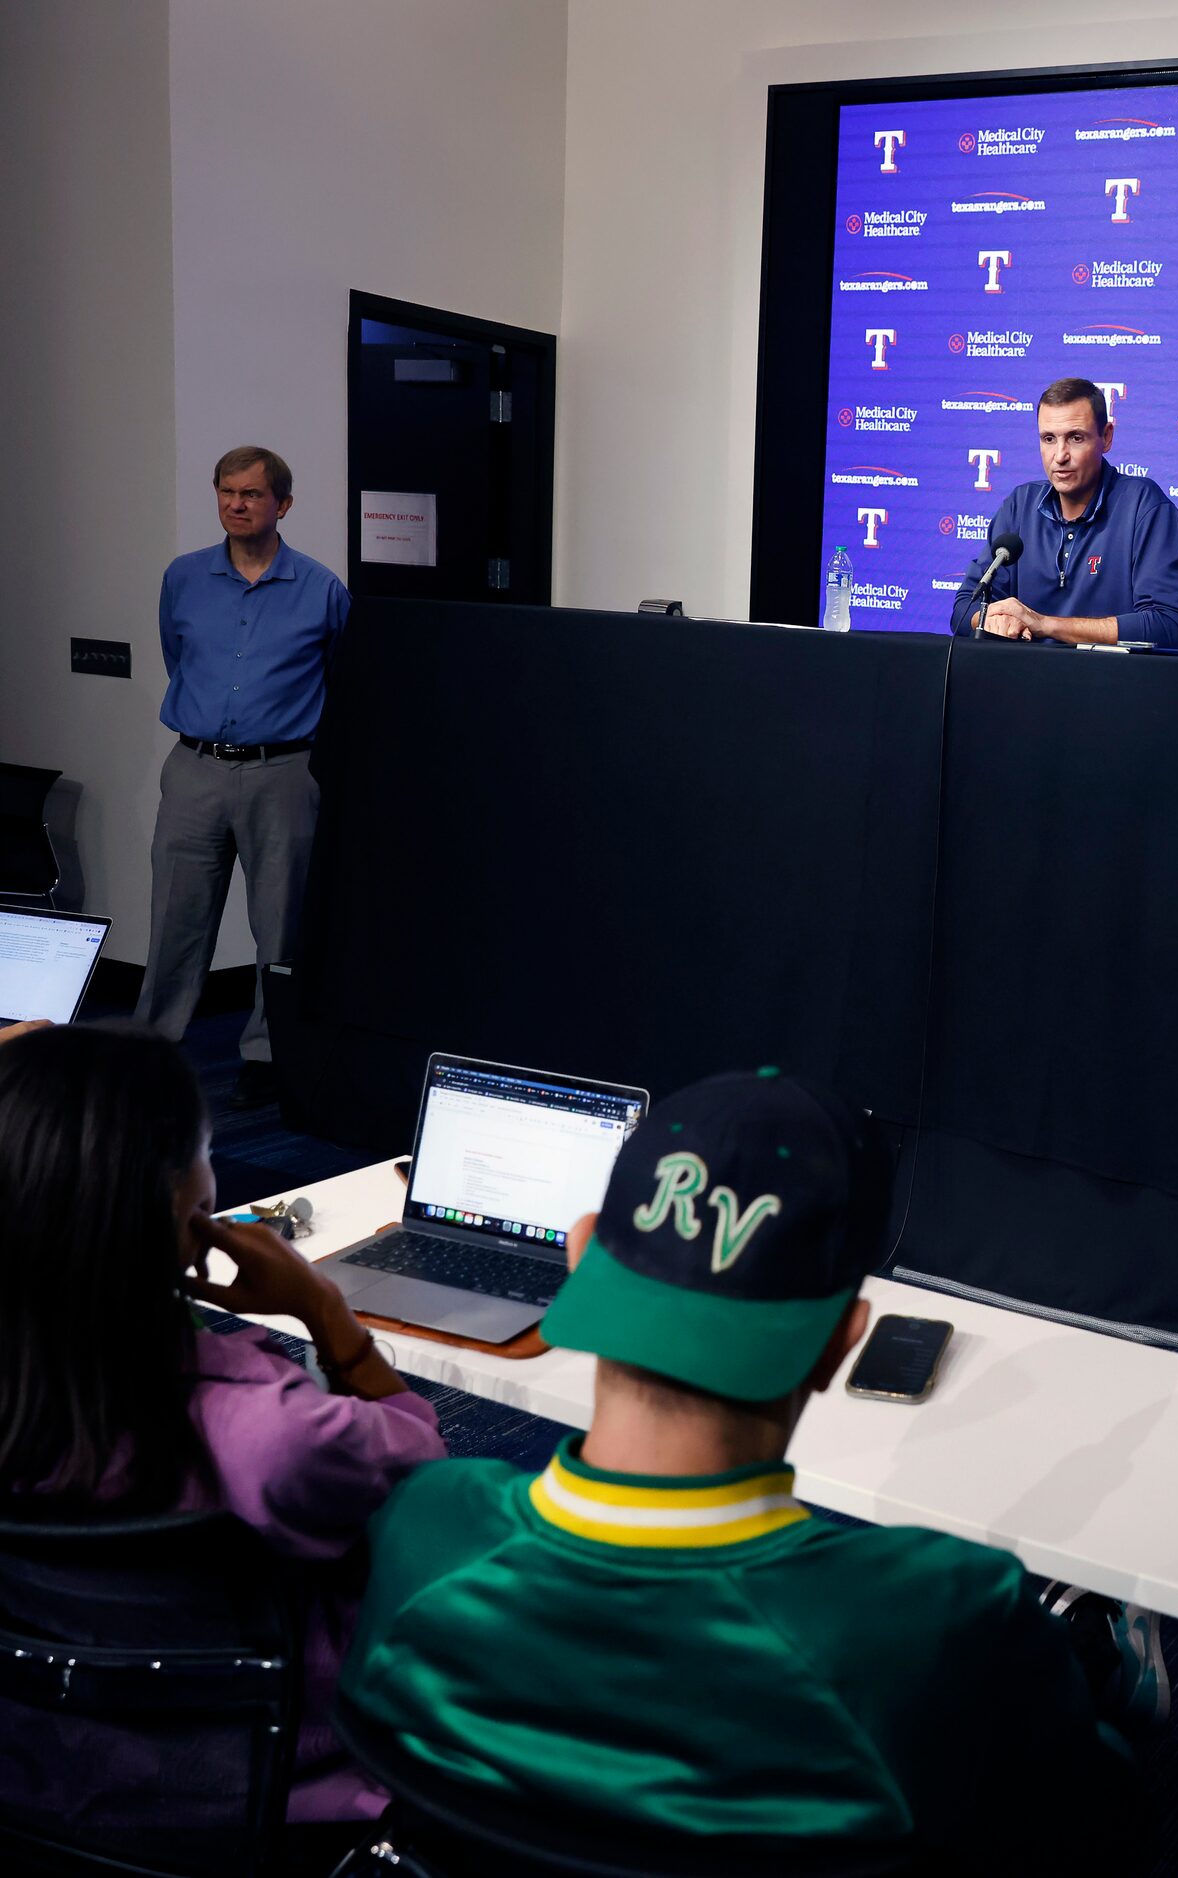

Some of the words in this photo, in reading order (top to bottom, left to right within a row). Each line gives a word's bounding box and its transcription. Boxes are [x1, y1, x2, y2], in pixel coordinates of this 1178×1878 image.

[978, 128, 1021, 142] Medical
[1022, 128, 1045, 143] City
[1075, 127, 1176, 140] texasrangers.com
[874, 130, 906, 173] T
[951, 201, 1045, 214] texasrangers.com
[1105, 178, 1141, 223] T
[864, 210, 904, 224] Medical
[906, 210, 927, 226] City
[978, 251, 1012, 294] T
[1092, 260, 1137, 274] Medical
[1139, 260, 1162, 276] City
[840, 280, 928, 293] texasrangers.com
[967, 331, 1009, 344] Medical
[1010, 332, 1033, 347] City
[1063, 333, 1161, 346] texasrangers.com
[865, 329, 897, 370] T
[942, 400, 1033, 412] texasrangers.com
[856, 406, 895, 418] Medical
[896, 407, 918, 422] City
[968, 449, 1001, 491] T
[1125, 464, 1149, 477] City
[832, 473, 918, 487] texasrangers.com
[858, 508, 888, 548] T
[957, 515, 992, 527] Medic
[957, 528, 988, 540] Healt
[1088, 556, 1102, 575] T
[888, 585, 909, 600] City
